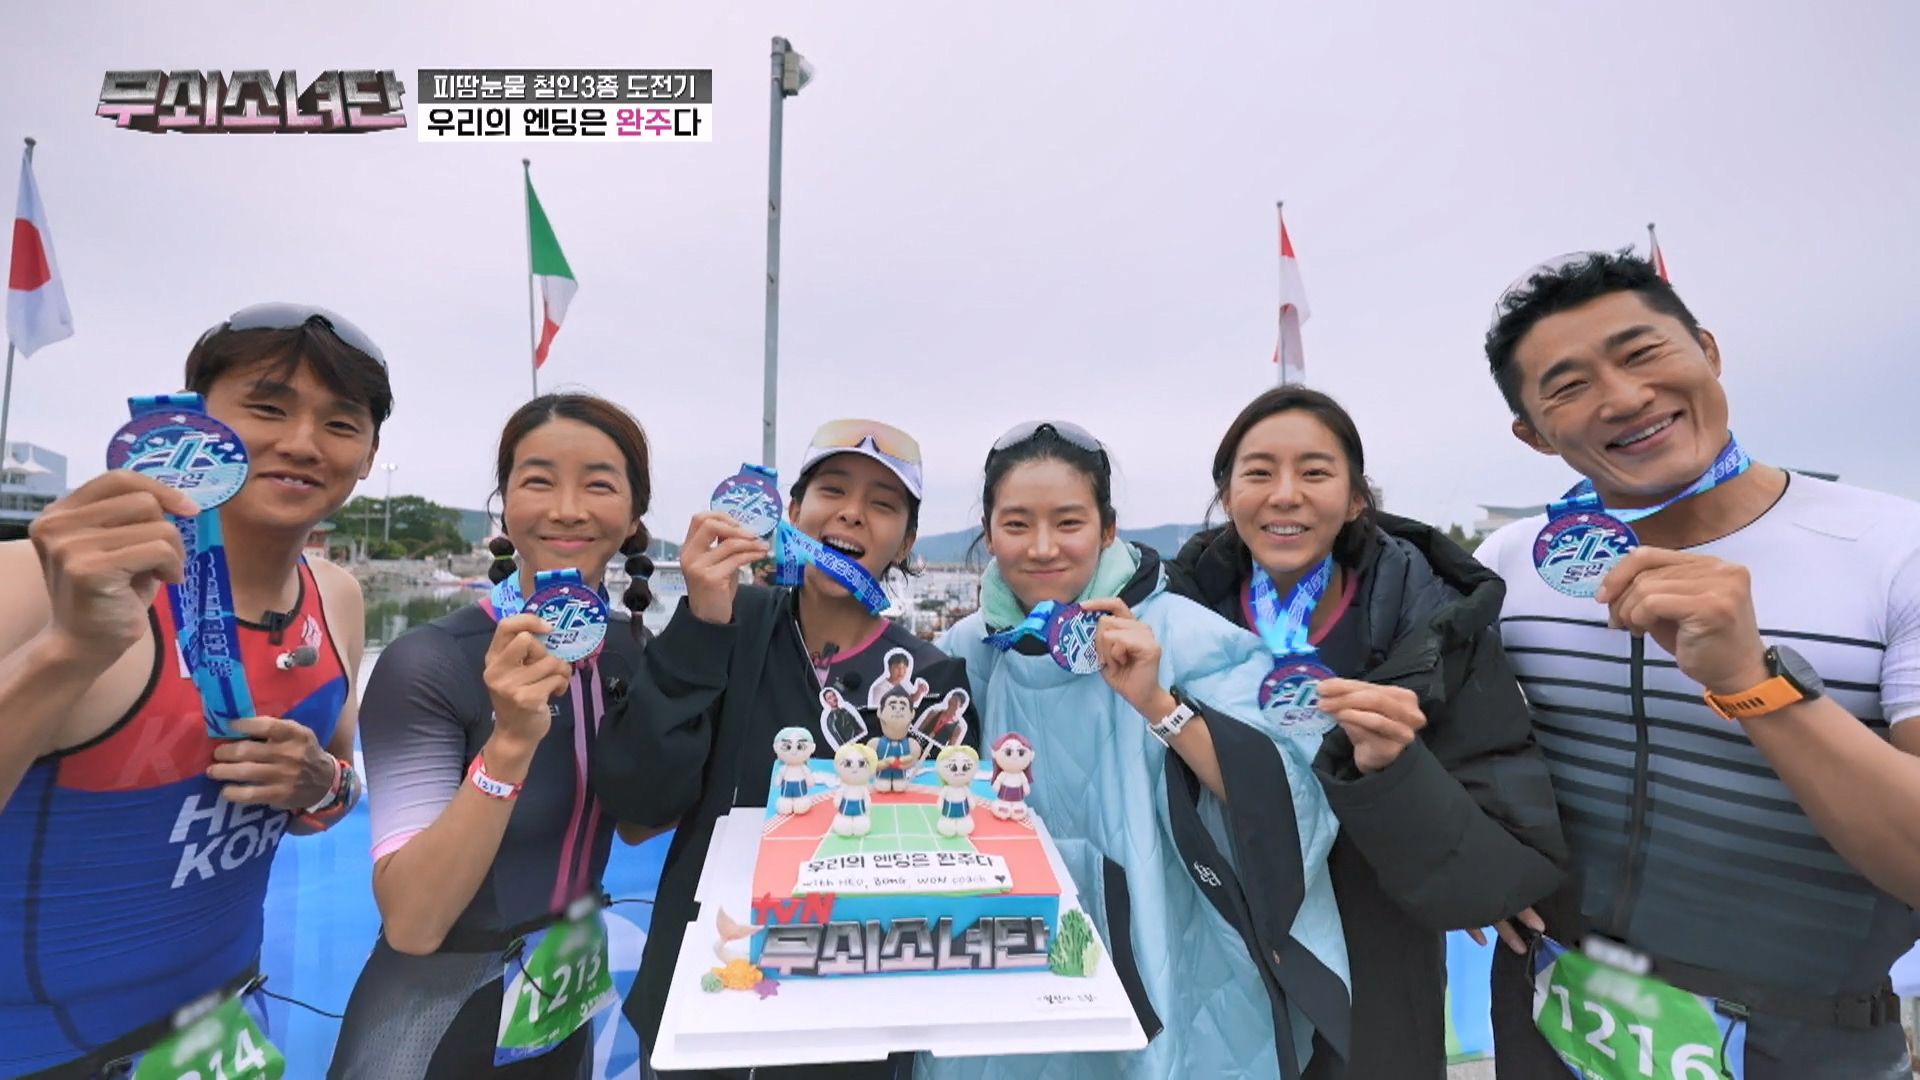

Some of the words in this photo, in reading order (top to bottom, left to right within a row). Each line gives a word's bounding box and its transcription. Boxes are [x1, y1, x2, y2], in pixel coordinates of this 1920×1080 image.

[168, 793, 265, 844] HE
[171, 811, 289, 889] KOR
[808, 855, 865, 873] 우리의
[873, 853, 931, 869] 엔딩은
[937, 853, 993, 868] 완주다
[752, 893, 838, 925] tvN
[758, 916, 1051, 976] 무쇠소녀단
[521, 947, 602, 1024] 1213
[176, 1028, 267, 1080] 14
[1550, 984, 1722, 1080] 1216
